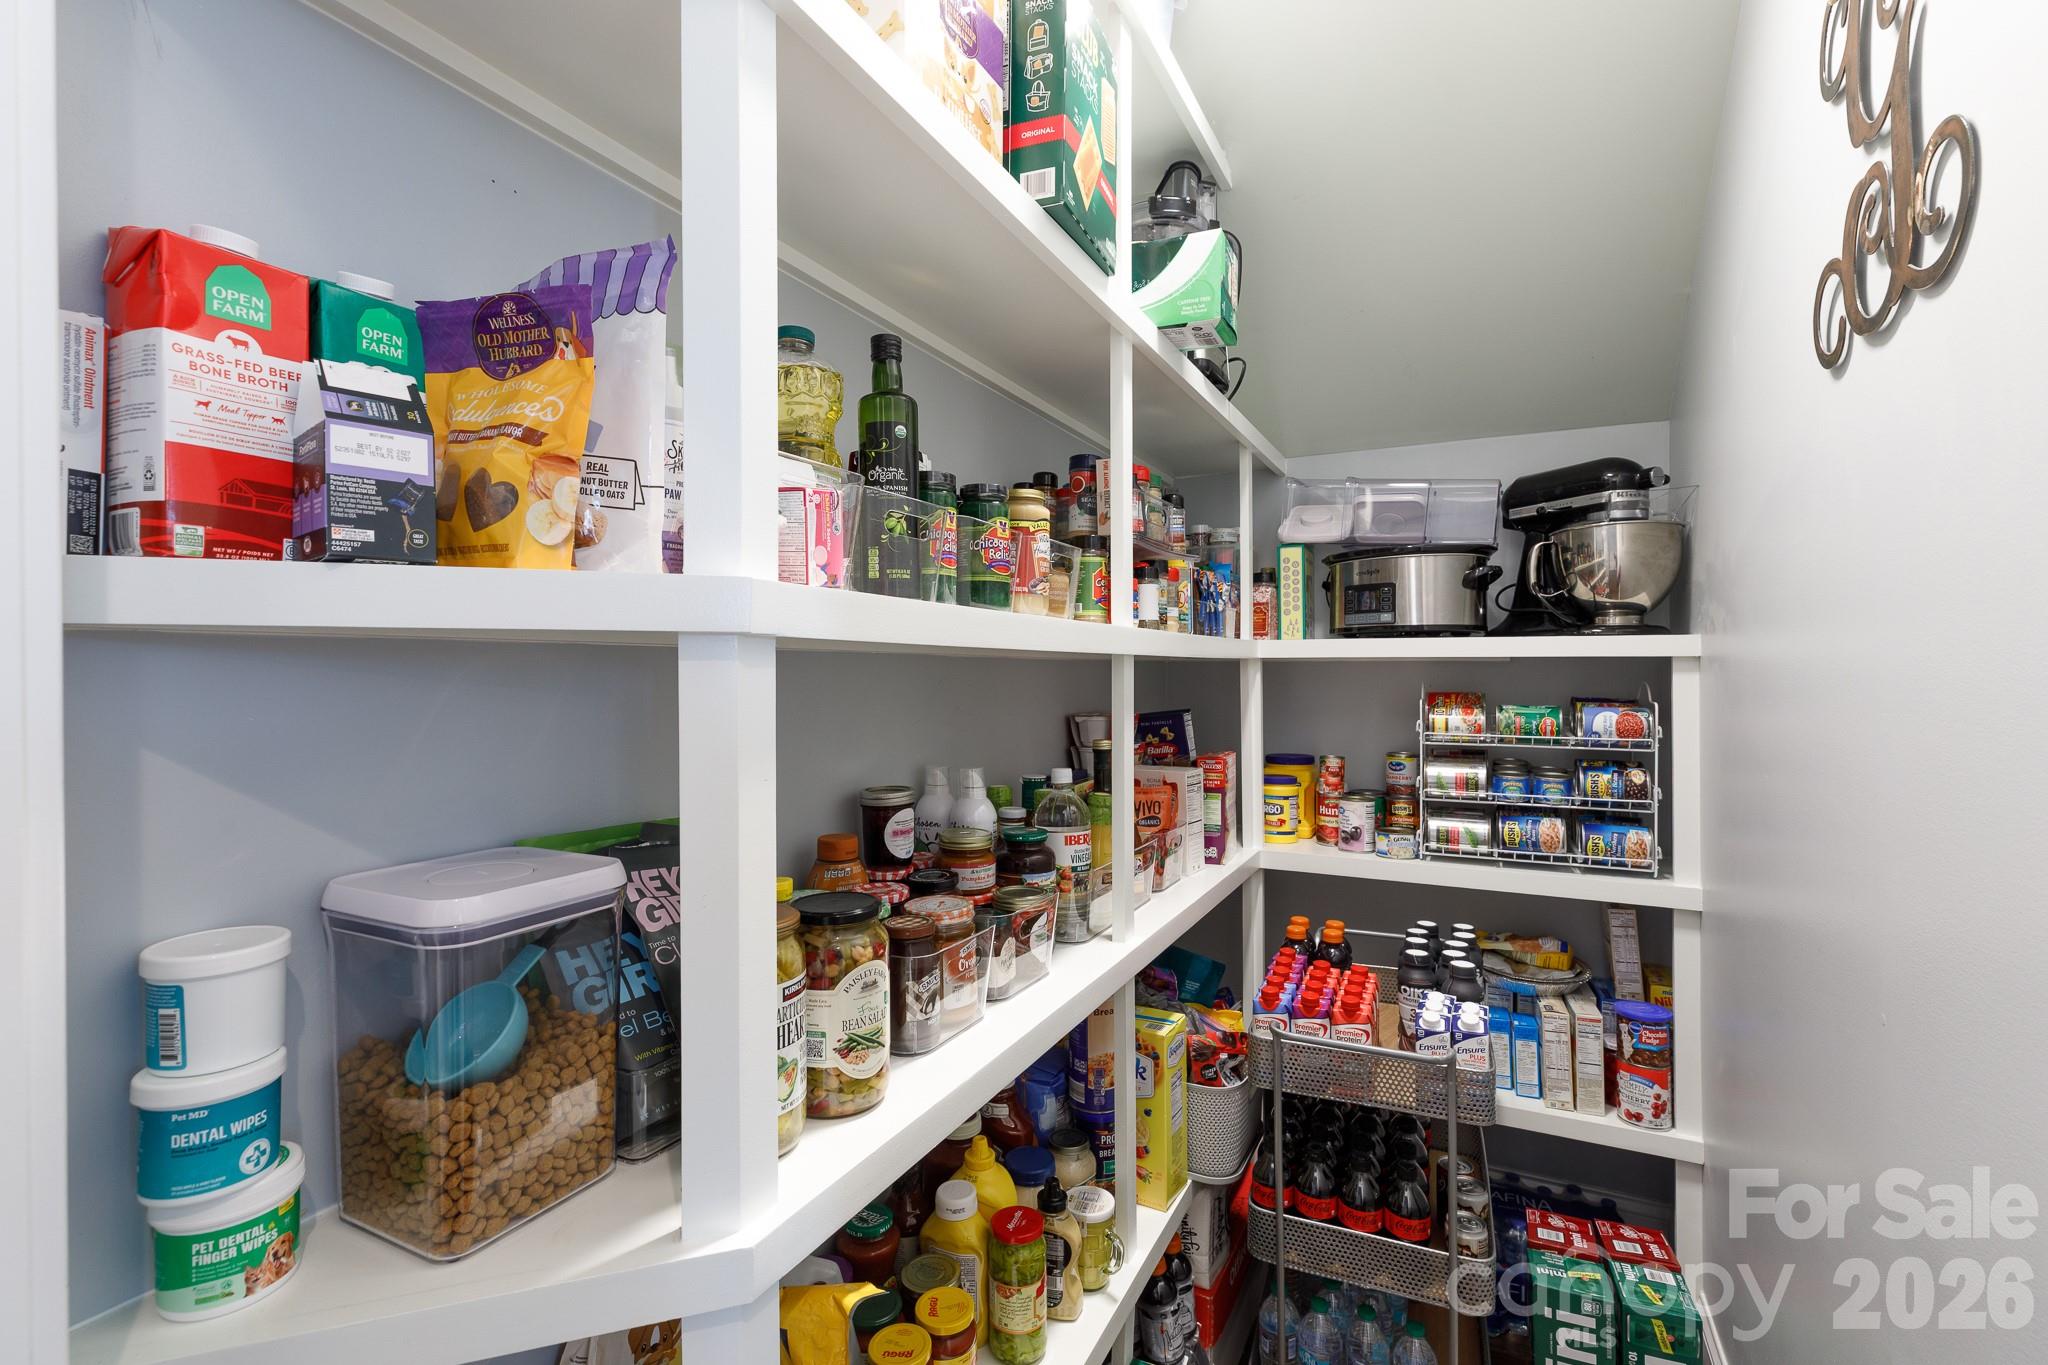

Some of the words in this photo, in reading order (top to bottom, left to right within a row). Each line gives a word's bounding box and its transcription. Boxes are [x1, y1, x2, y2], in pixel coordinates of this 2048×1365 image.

[1025, 4, 1054, 15] STACKS
[1021, 127, 1055, 139] ORIGINAL
[212, 286, 264, 309] OPEN
[213, 299, 265, 323] FARM
[488, 312, 536, 330] WELLNESS
[361, 327, 402, 346] OPEN
[477, 333, 501, 347] OLD
[503, 327, 551, 344] MOTHER
[362, 339, 402, 359] FARM
[489, 344, 544, 361] HUBBARD
[171, 342, 263, 373] GRASS-FED
[269, 367, 302, 383] BEEF
[189, 360, 231, 380] BONE
[238, 373, 288, 392] BROTH
[84, 368, 96, 409] Ointment
[456, 380, 545, 400] WHOLESOME
[217, 404, 241, 416] Meal
[243, 409, 266, 421] Topper
[586, 461, 609, 472] REAL
[581, 477, 597, 486] NUT
[598, 478, 629, 490] BUTTER
[868, 470, 908, 483] Organic
[580, 486, 605, 498] OLLED
[606, 489, 625, 499] OATS
[664, 488, 682, 501] PAW
[1147, 746, 1174, 755] Barilla
[1319, 805, 1338, 816] Hun
[1138, 818, 1160, 826] ORGANICS
[1064, 834, 1091, 846] IBER
[1508, 821, 1518, 847] BUSH'S
[1591, 836, 1602, 857] USH'S
[1070, 852, 1091, 864] VINEGA
[625, 865, 680, 903] HEY
[648, 939, 666, 951] Time
[667, 935, 677, 945] to
[555, 931, 649, 986] HEY
[843, 968, 874, 995] PAISLEY
[842, 1014, 867, 1032] BEAN
[1295, 1022, 1321, 1033] premier
[1335, 1028, 1364, 1039] premier
[1336, 1034, 1362, 1044] protein
[1642, 1030, 1667, 1038] Chocolate
[1642, 1037, 1660, 1046] Fudge
[1419, 1043, 1448, 1052] Ensure
[1457, 1046, 1486, 1055] Ensure
[1469, 1053, 1486, 1062] PLUS
[1621, 1091, 1650, 1106] CHERRY
[171, 1112, 187, 1123] Pet
[188, 1109, 208, 1121] MD
[171, 1126, 228, 1148] DENTAL
[230, 1109, 267, 1135] WIPES
[192, 1239, 214, 1255] PET
[218, 1223, 266, 1249] DENTAL
[1570, 1232, 1584, 1248] mini
[192, 1248, 238, 1267] FINGER
[242, 1228, 278, 1255] WIPES
[1648, 1243, 1663, 1259] mini
[1537, 1267, 1567, 1278] mini
[1621, 1263, 1638, 1282] mini
[928, 1295, 939, 1318] RAGÚ
[882, 1350, 914, 1358] RAGÚ
